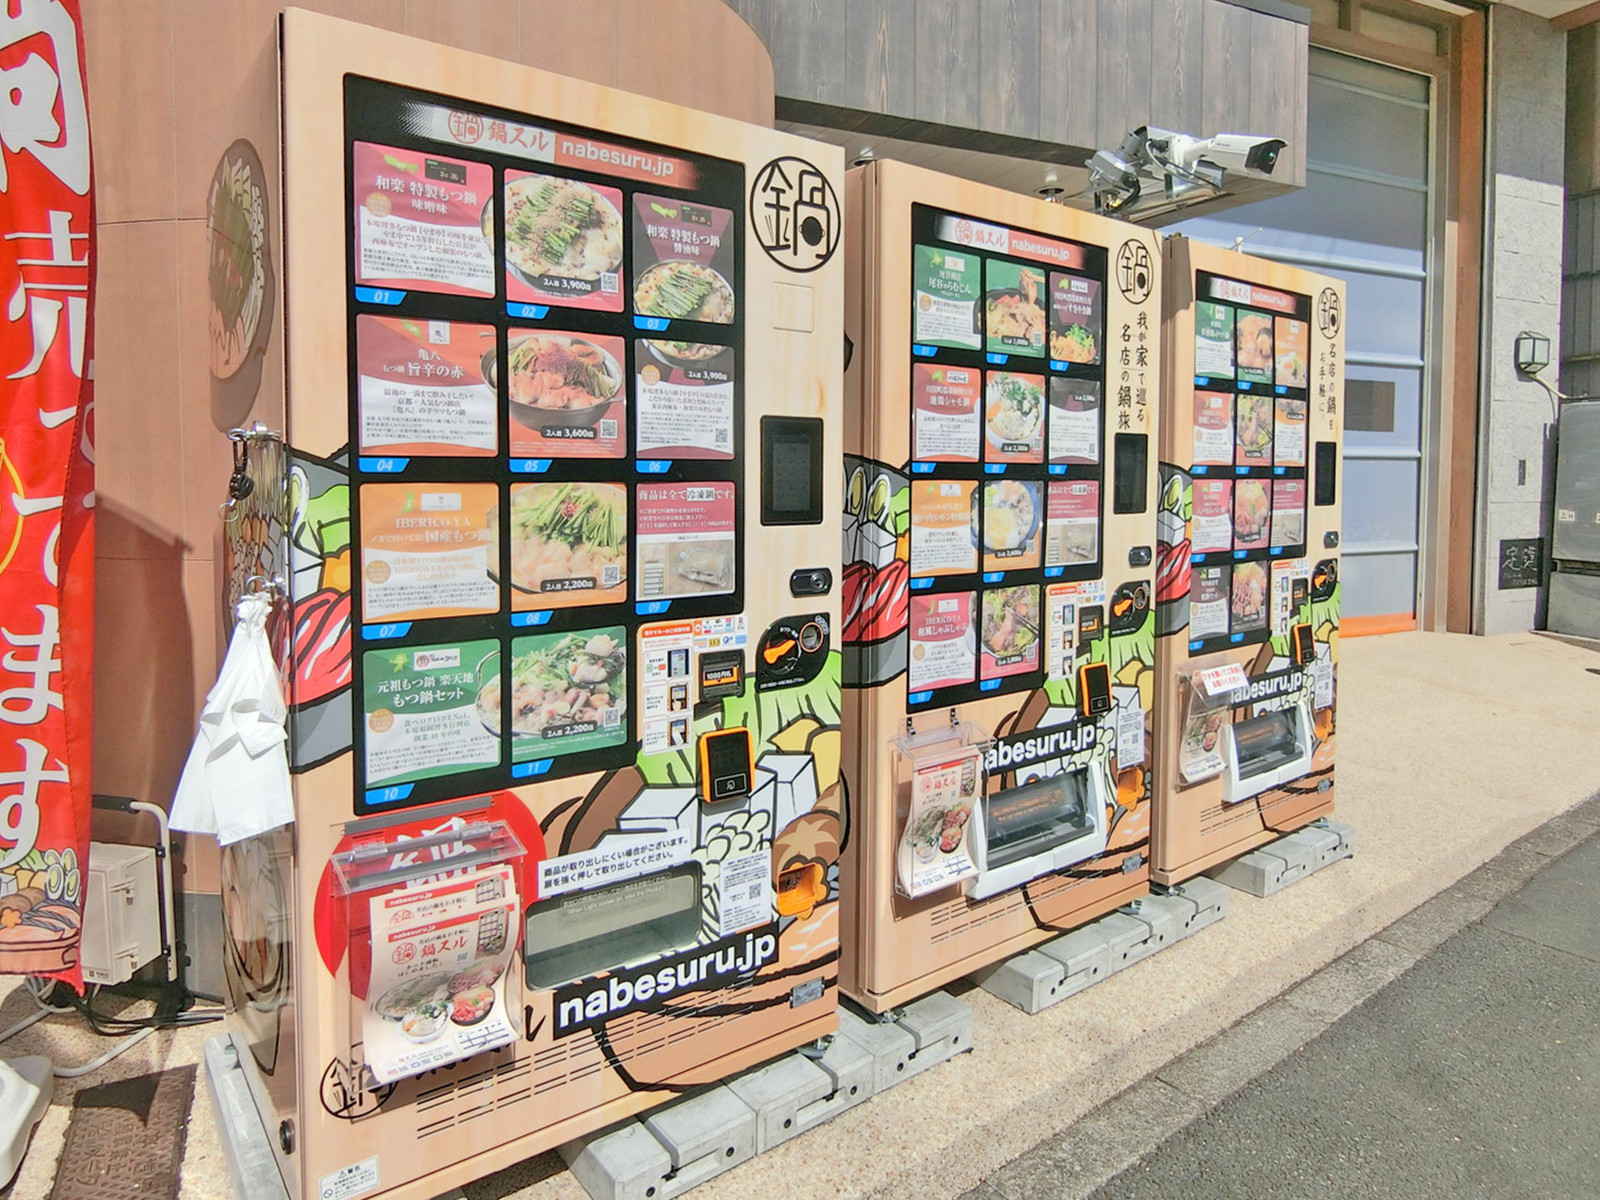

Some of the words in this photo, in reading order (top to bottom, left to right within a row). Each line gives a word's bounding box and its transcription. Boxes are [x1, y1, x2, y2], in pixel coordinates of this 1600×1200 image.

[489, 120, 549, 152] 鍋スル
[562, 140, 675, 177] nabesuru.jp
[376, 175, 405, 193] 和楽
[409, 181, 478, 206] 特製もつ鍋
[671, 229, 721, 248] 特製もつ鍋
[1012, 238, 1070, 261] nabesuru.jp
[374, 290, 389, 302] 01
[522, 305, 536, 317] 02
[647, 318, 660, 329] 03
[418, 348, 441, 361] 亀八
[408, 361, 464, 380] 旨辛の赤
[1117, 322, 1133, 430] 名店の鍋旅
[377, 460, 393, 471] 04
[525, 460, 538, 472] 05
[649, 460, 661, 472] 06
[425, 528, 491, 544] 国産もつ鍋
[649, 602, 661, 614] 09
[526, 612, 540, 624] 08
[380, 625, 397, 638] 07
[377, 675, 436, 694] 元祖もつ鍋
[440, 672, 475, 687] 楽天地
[392, 687, 465, 708] もつ鍋セット
[527, 762, 540, 774] 11
[384, 788, 399, 800] 10
[544, 836, 688, 877] 商品が取り出しにくい場合がございます。
[544, 852, 674, 889] 扉を強く押して取り出してください。
[421, 936, 468, 958] 鍋スル
[559, 932, 775, 1029] nabesuru.jp
